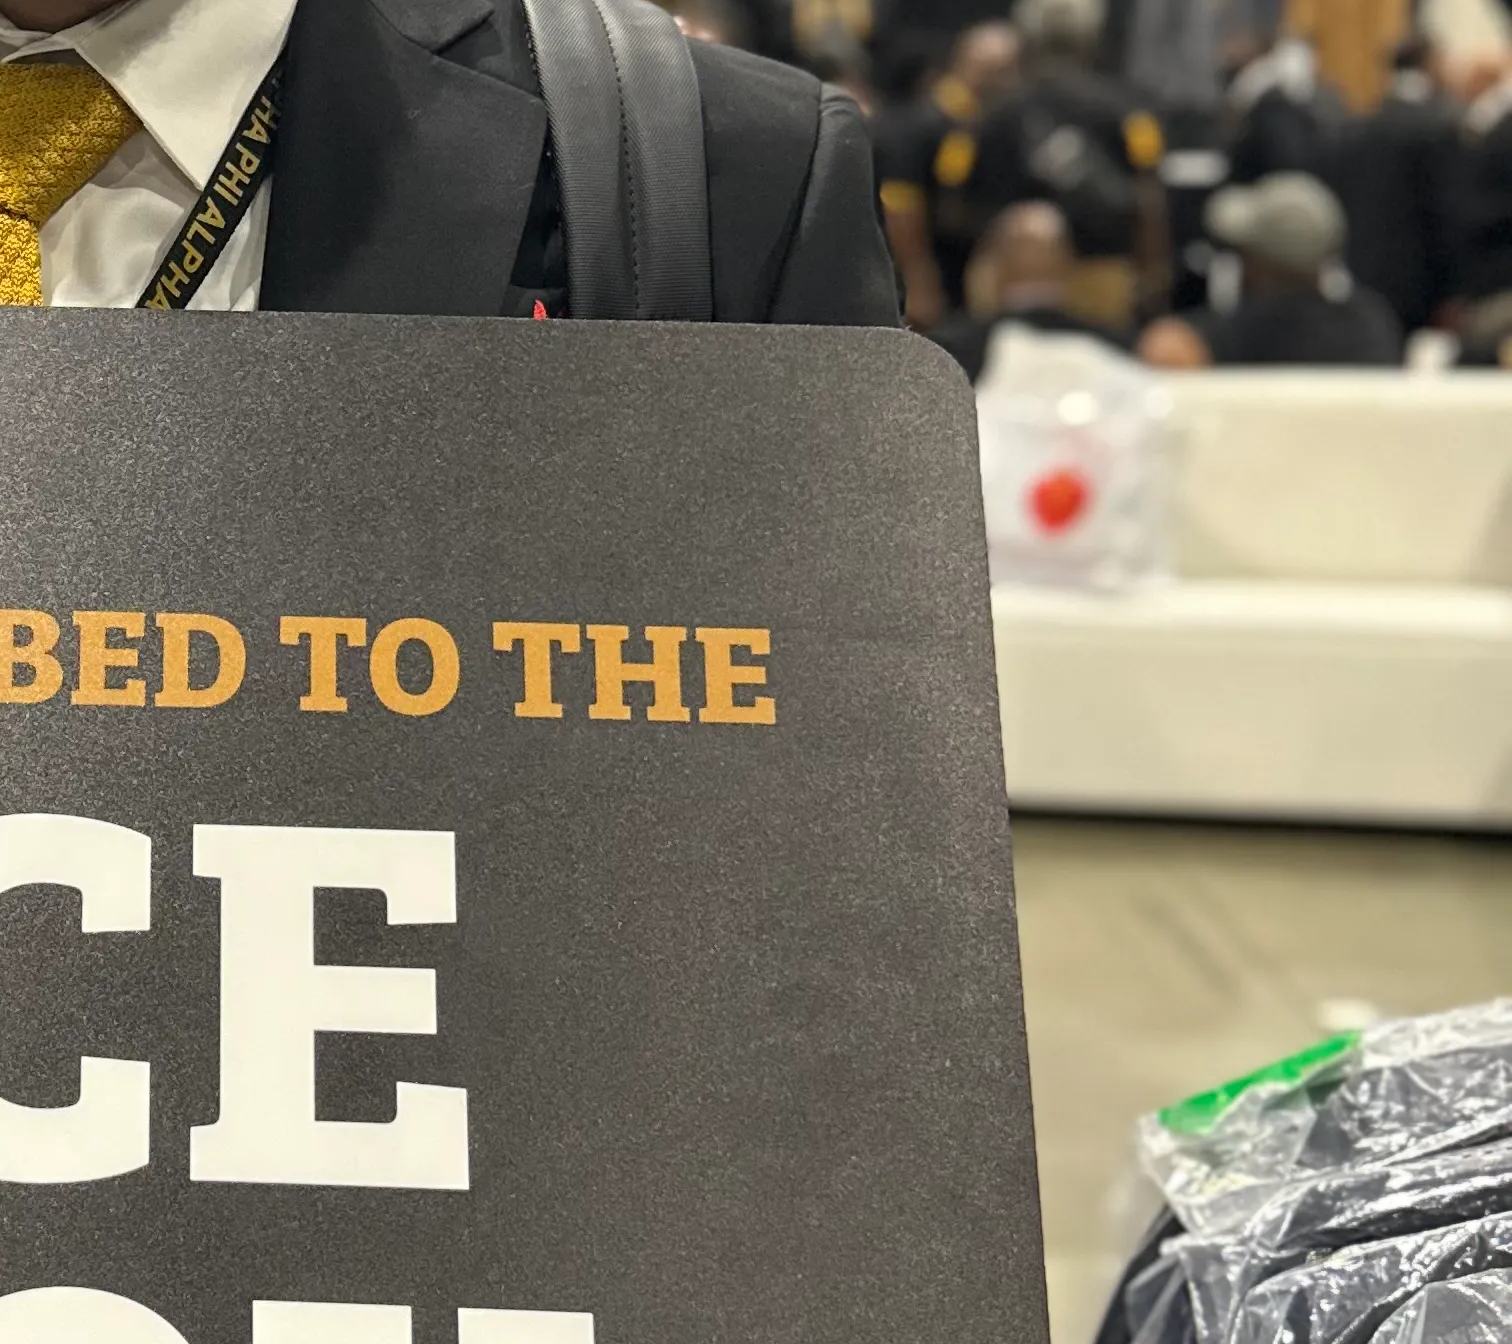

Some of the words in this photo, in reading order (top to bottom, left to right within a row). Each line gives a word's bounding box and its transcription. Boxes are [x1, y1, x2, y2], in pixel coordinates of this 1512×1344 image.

[213, 142, 261, 207] PHI
[145, 196, 226, 311] ALPHA
[278, 615, 462, 717] TO
[492, 620, 778, 726] THE
